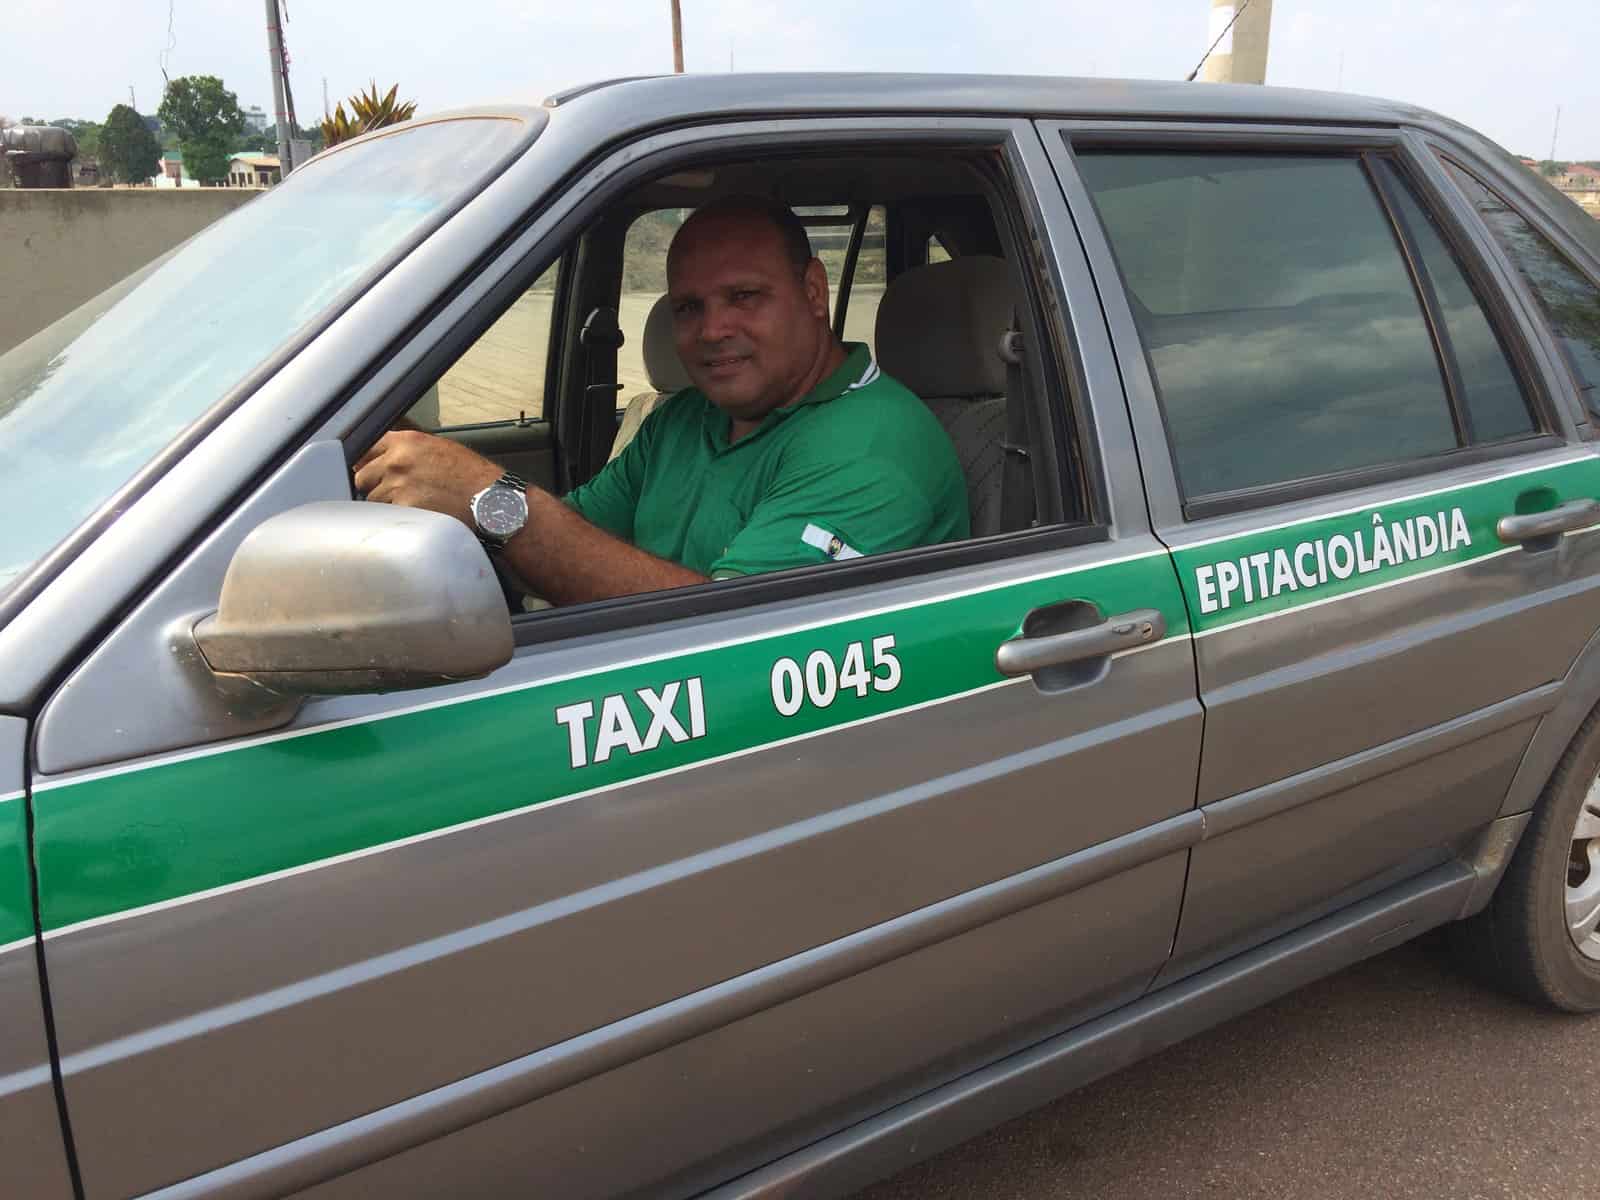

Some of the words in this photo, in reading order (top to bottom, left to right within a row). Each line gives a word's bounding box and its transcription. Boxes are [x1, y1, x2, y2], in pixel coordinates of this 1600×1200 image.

[1195, 507, 1472, 616] EPITACIOLÂNDIA
[555, 676, 706, 769] TAXI
[770, 634, 902, 717] 0045
